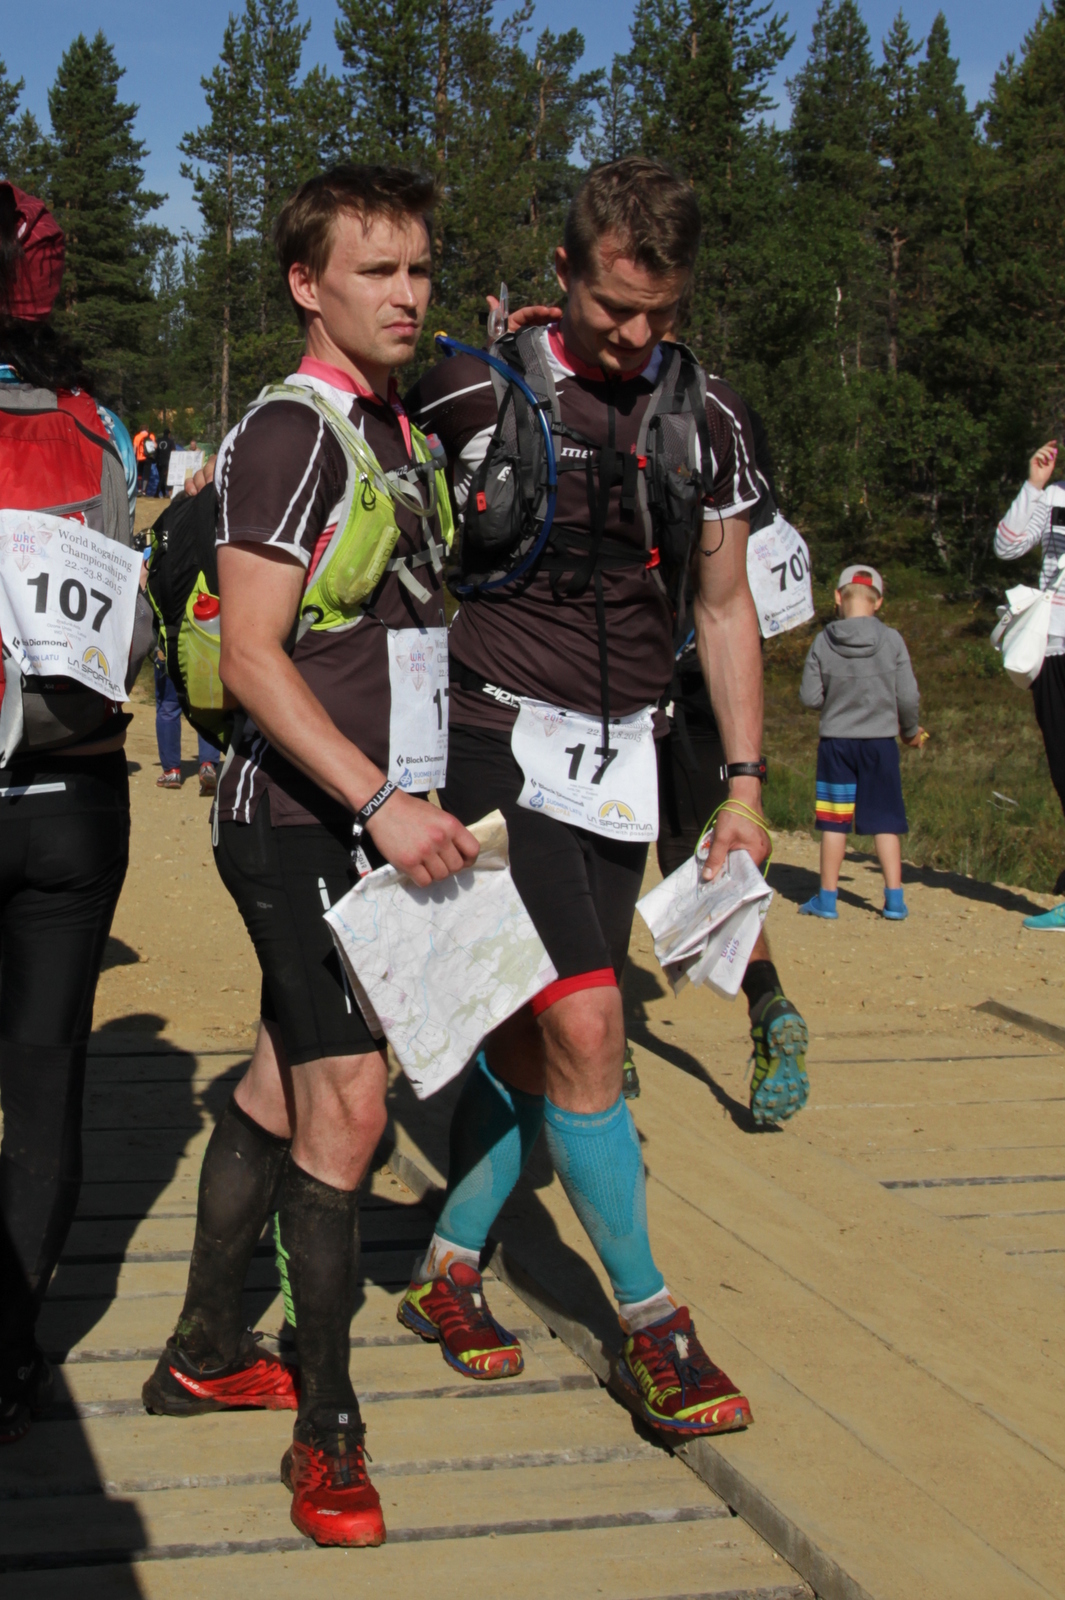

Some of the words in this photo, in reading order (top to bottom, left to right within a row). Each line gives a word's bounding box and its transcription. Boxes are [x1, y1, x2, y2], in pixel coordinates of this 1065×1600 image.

[12, 533, 36, 544] WRC
[12, 543, 36, 554] 2015
[58, 528, 88, 548] World
[91, 541, 132, 573] Rogaining
[61, 543, 127, 582] Championships
[65, 559, 122, 596] 22.-23.8.2015
[27, 572, 112, 632] 107
[28, 638, 68, 648] Diamond
[67, 657, 80, 668] LA
[410, 652, 426, 662] WRC
[410, 662, 426, 672] 2015
[544, 712, 564, 724] 2015
[406, 756, 423, 764] Black
[565, 742, 619, 785] 17
[599, 818, 653, 831] SPORTIVA
[629, 829, 654, 837] passion
[727, 938, 740, 964] 2015
